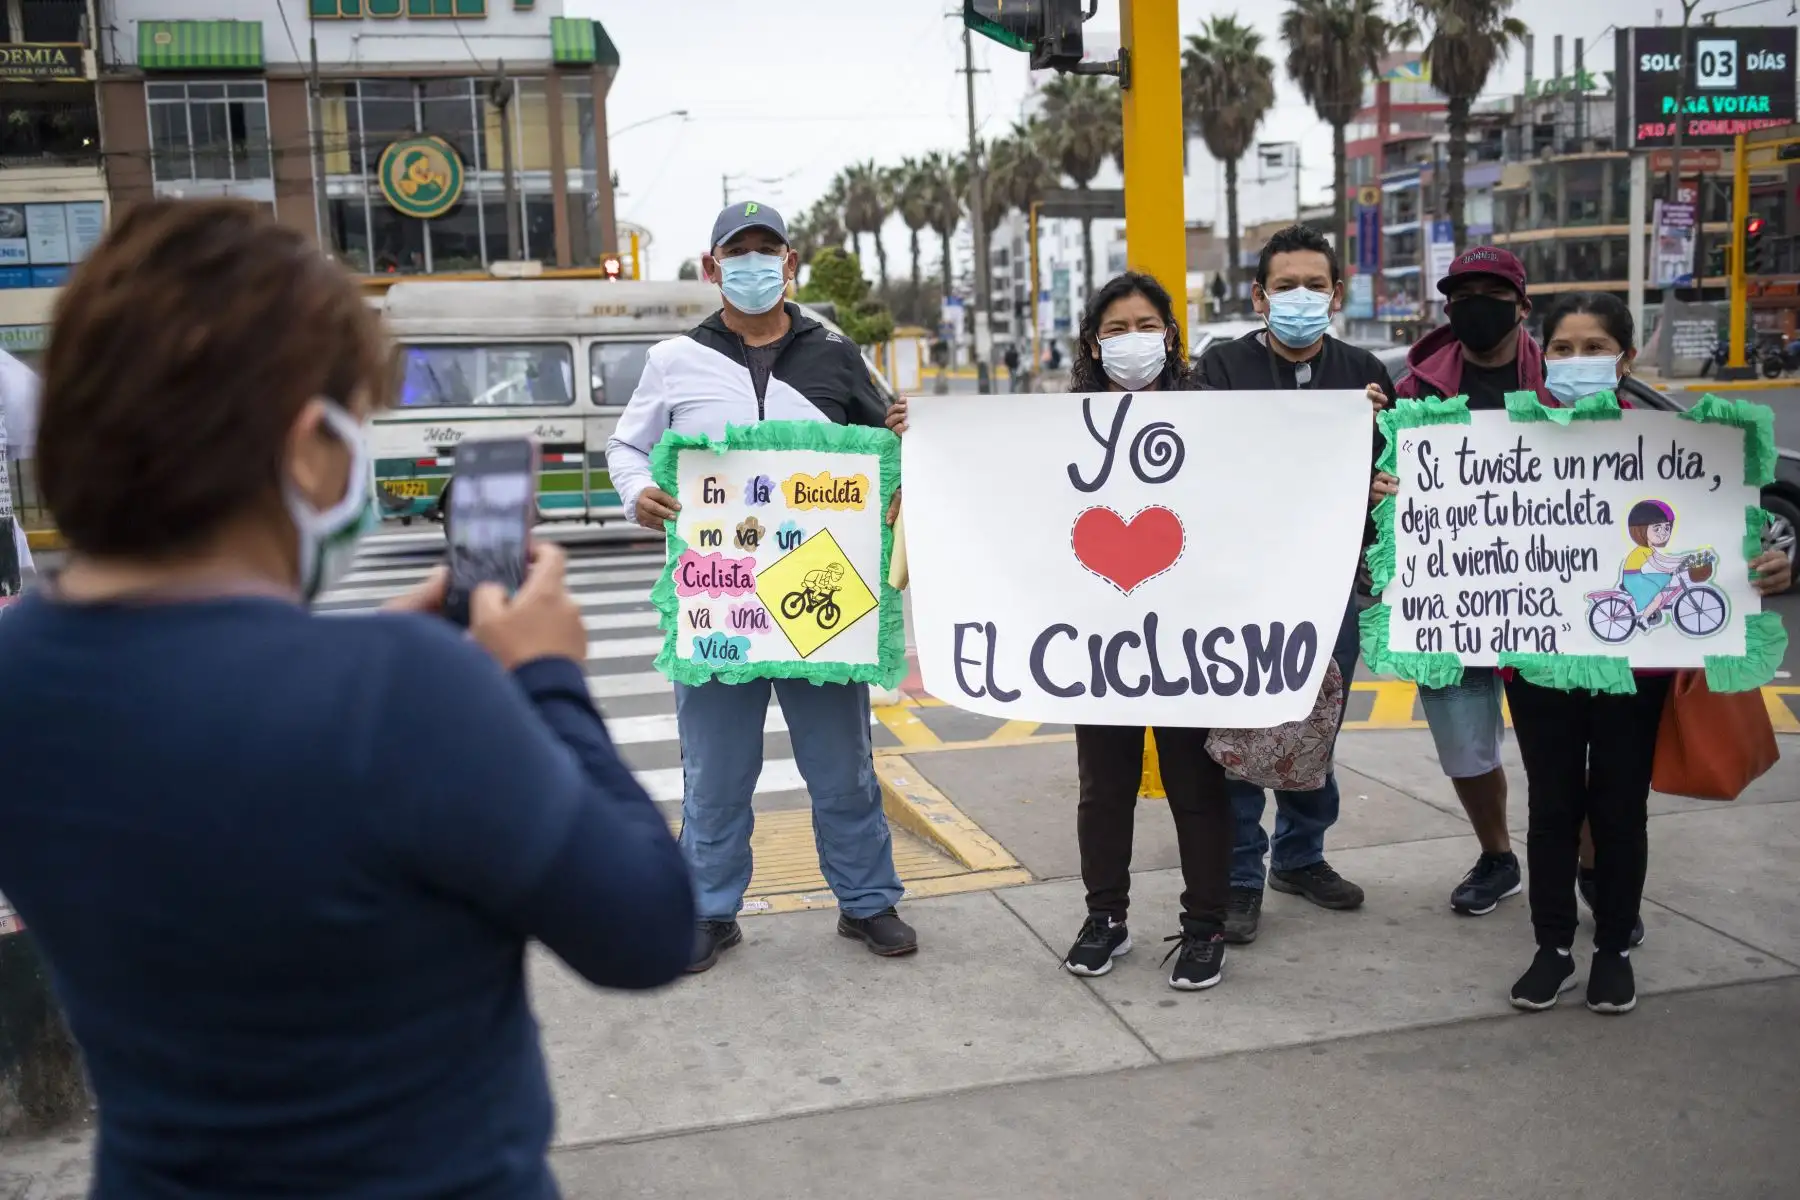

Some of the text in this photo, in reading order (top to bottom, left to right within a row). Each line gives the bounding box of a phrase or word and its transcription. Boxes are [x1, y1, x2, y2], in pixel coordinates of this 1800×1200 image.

[1700, 51, 1733, 77] 03
[1746, 49, 1786, 71] DÍAS
[1712, 95, 1770, 113] VOTAR
[1455, 435, 1542, 486] tuviste
[1553, 455, 1585, 480] un
[1592, 434, 1644, 482] mal
[703, 475, 863, 504] En la Bicicleta
[1401, 488, 1614, 546] deja que tu bicicleta
[700, 528, 802, 551] no va un
[682, 561, 754, 589] Ciclista
[1402, 534, 1599, 588] y el viento dibujen
[1402, 582, 1563, 621] una sonrisa
[688, 607, 769, 630] va una
[698, 640, 740, 661] Vida
[1416, 626, 1442, 653] en
[1449, 620, 1481, 654] tu
[1029, 611, 1318, 699] CICLISMO
